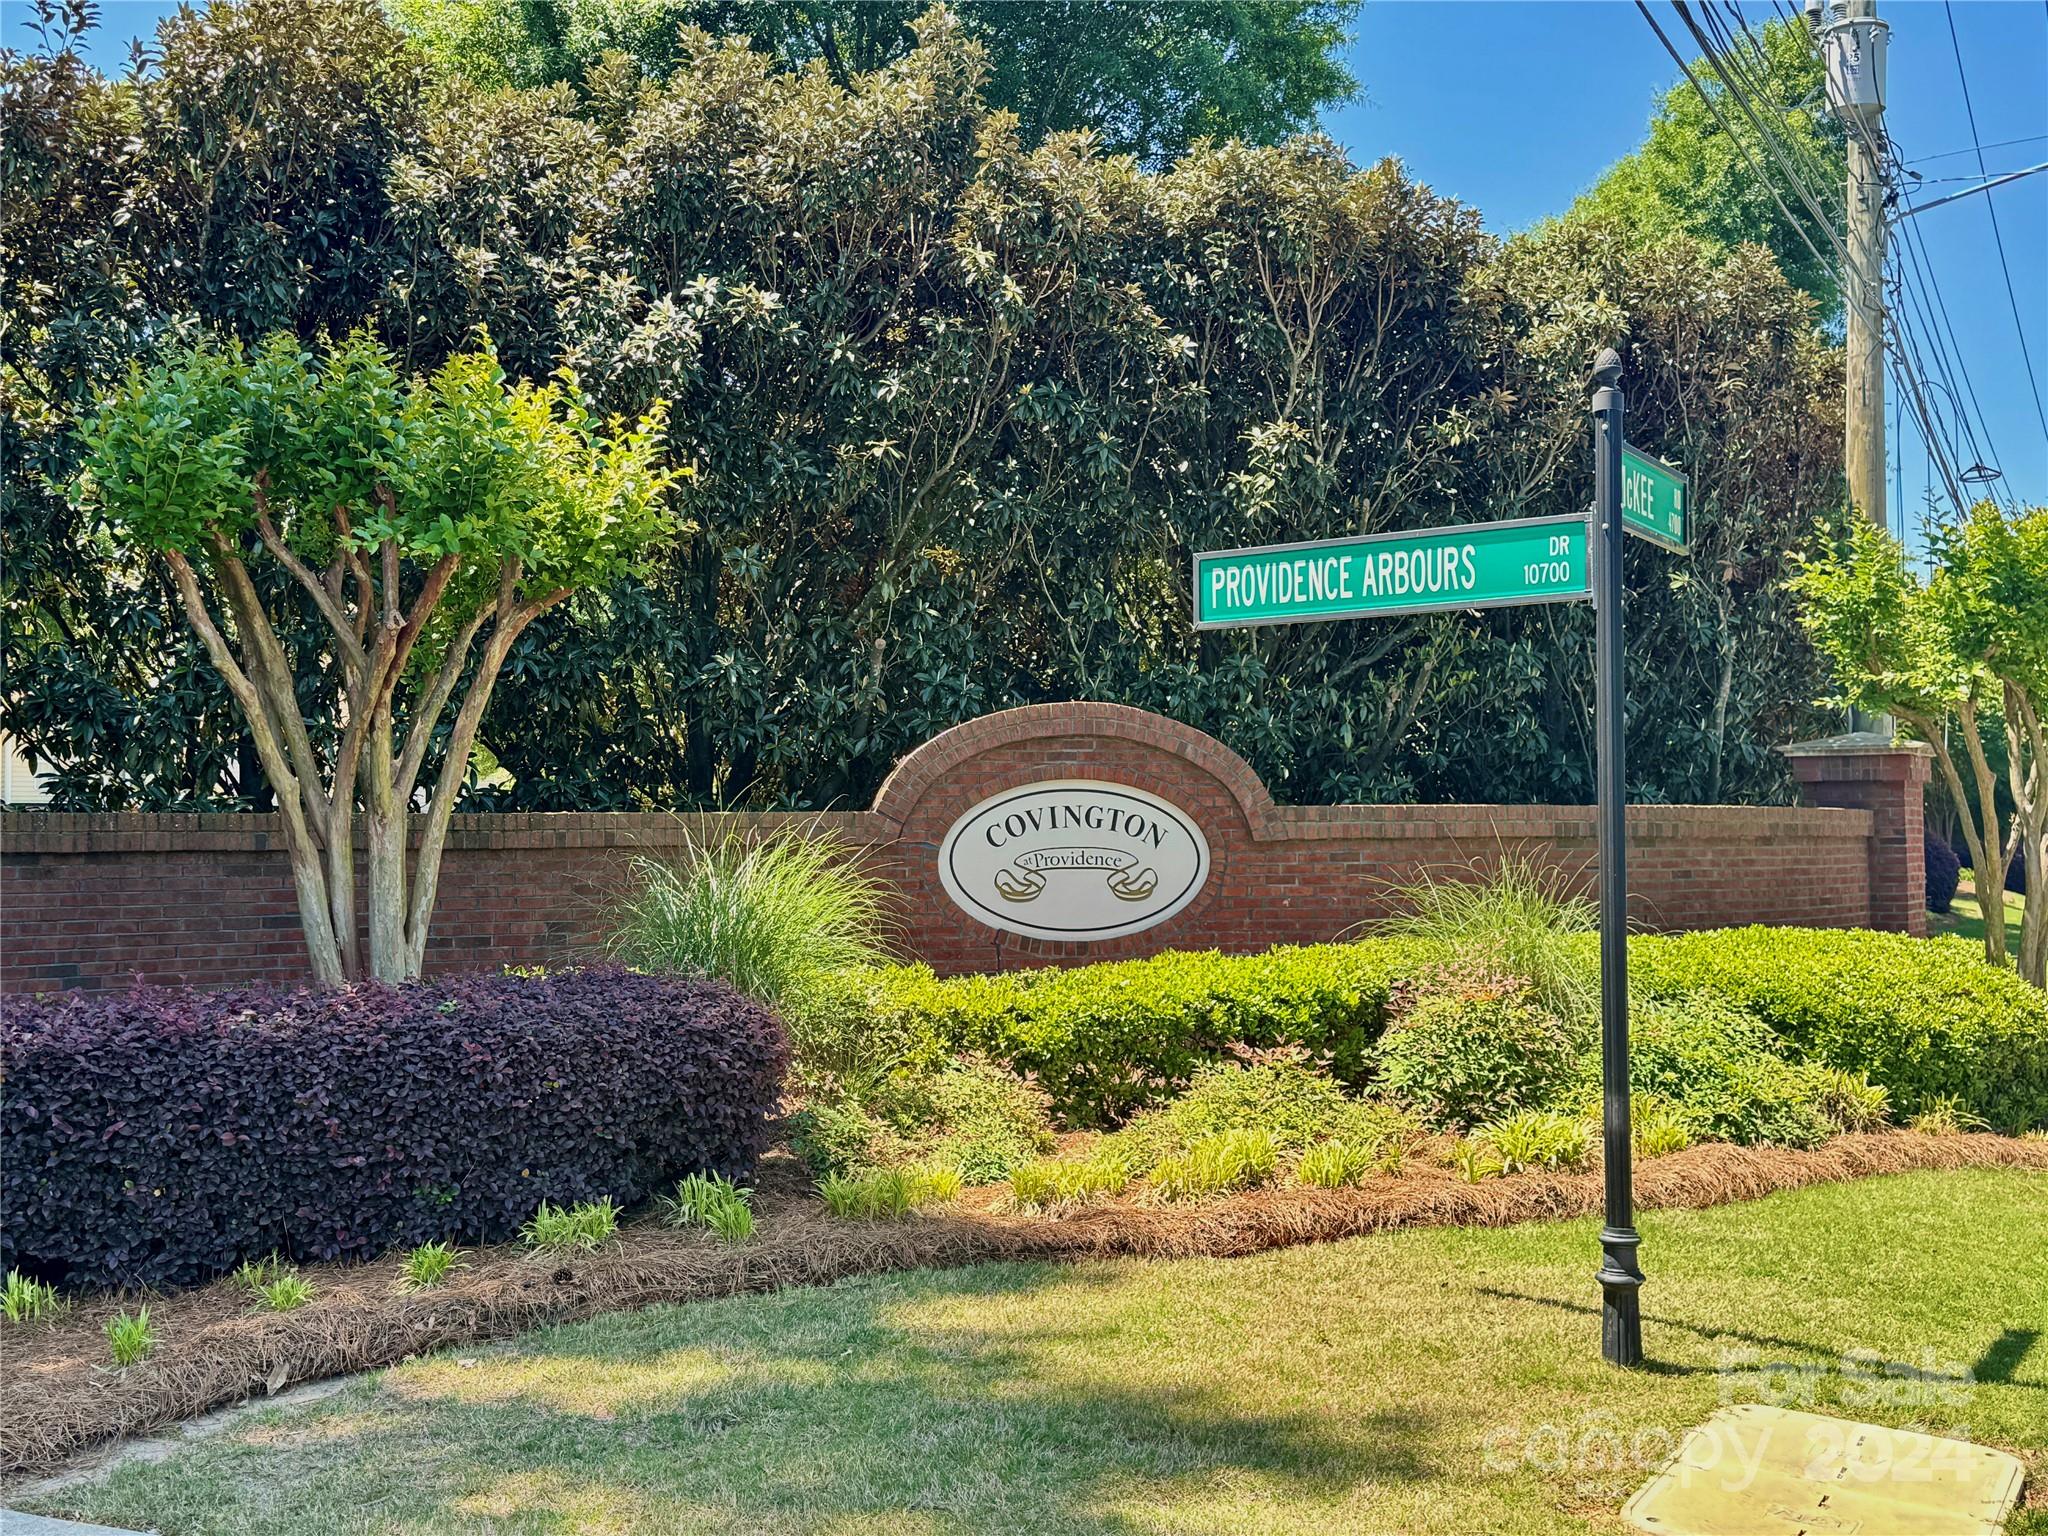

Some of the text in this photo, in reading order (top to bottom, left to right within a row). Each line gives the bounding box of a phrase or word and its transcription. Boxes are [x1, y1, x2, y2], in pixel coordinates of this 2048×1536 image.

[1549, 535, 1570, 557] DR
[1212, 544, 1476, 609] PROVIDENCE ARBOURS
[1523, 561, 1570, 585] 10700
[985, 804, 1168, 848] COVINGTON
[1023, 850, 1122, 868] at Providence
